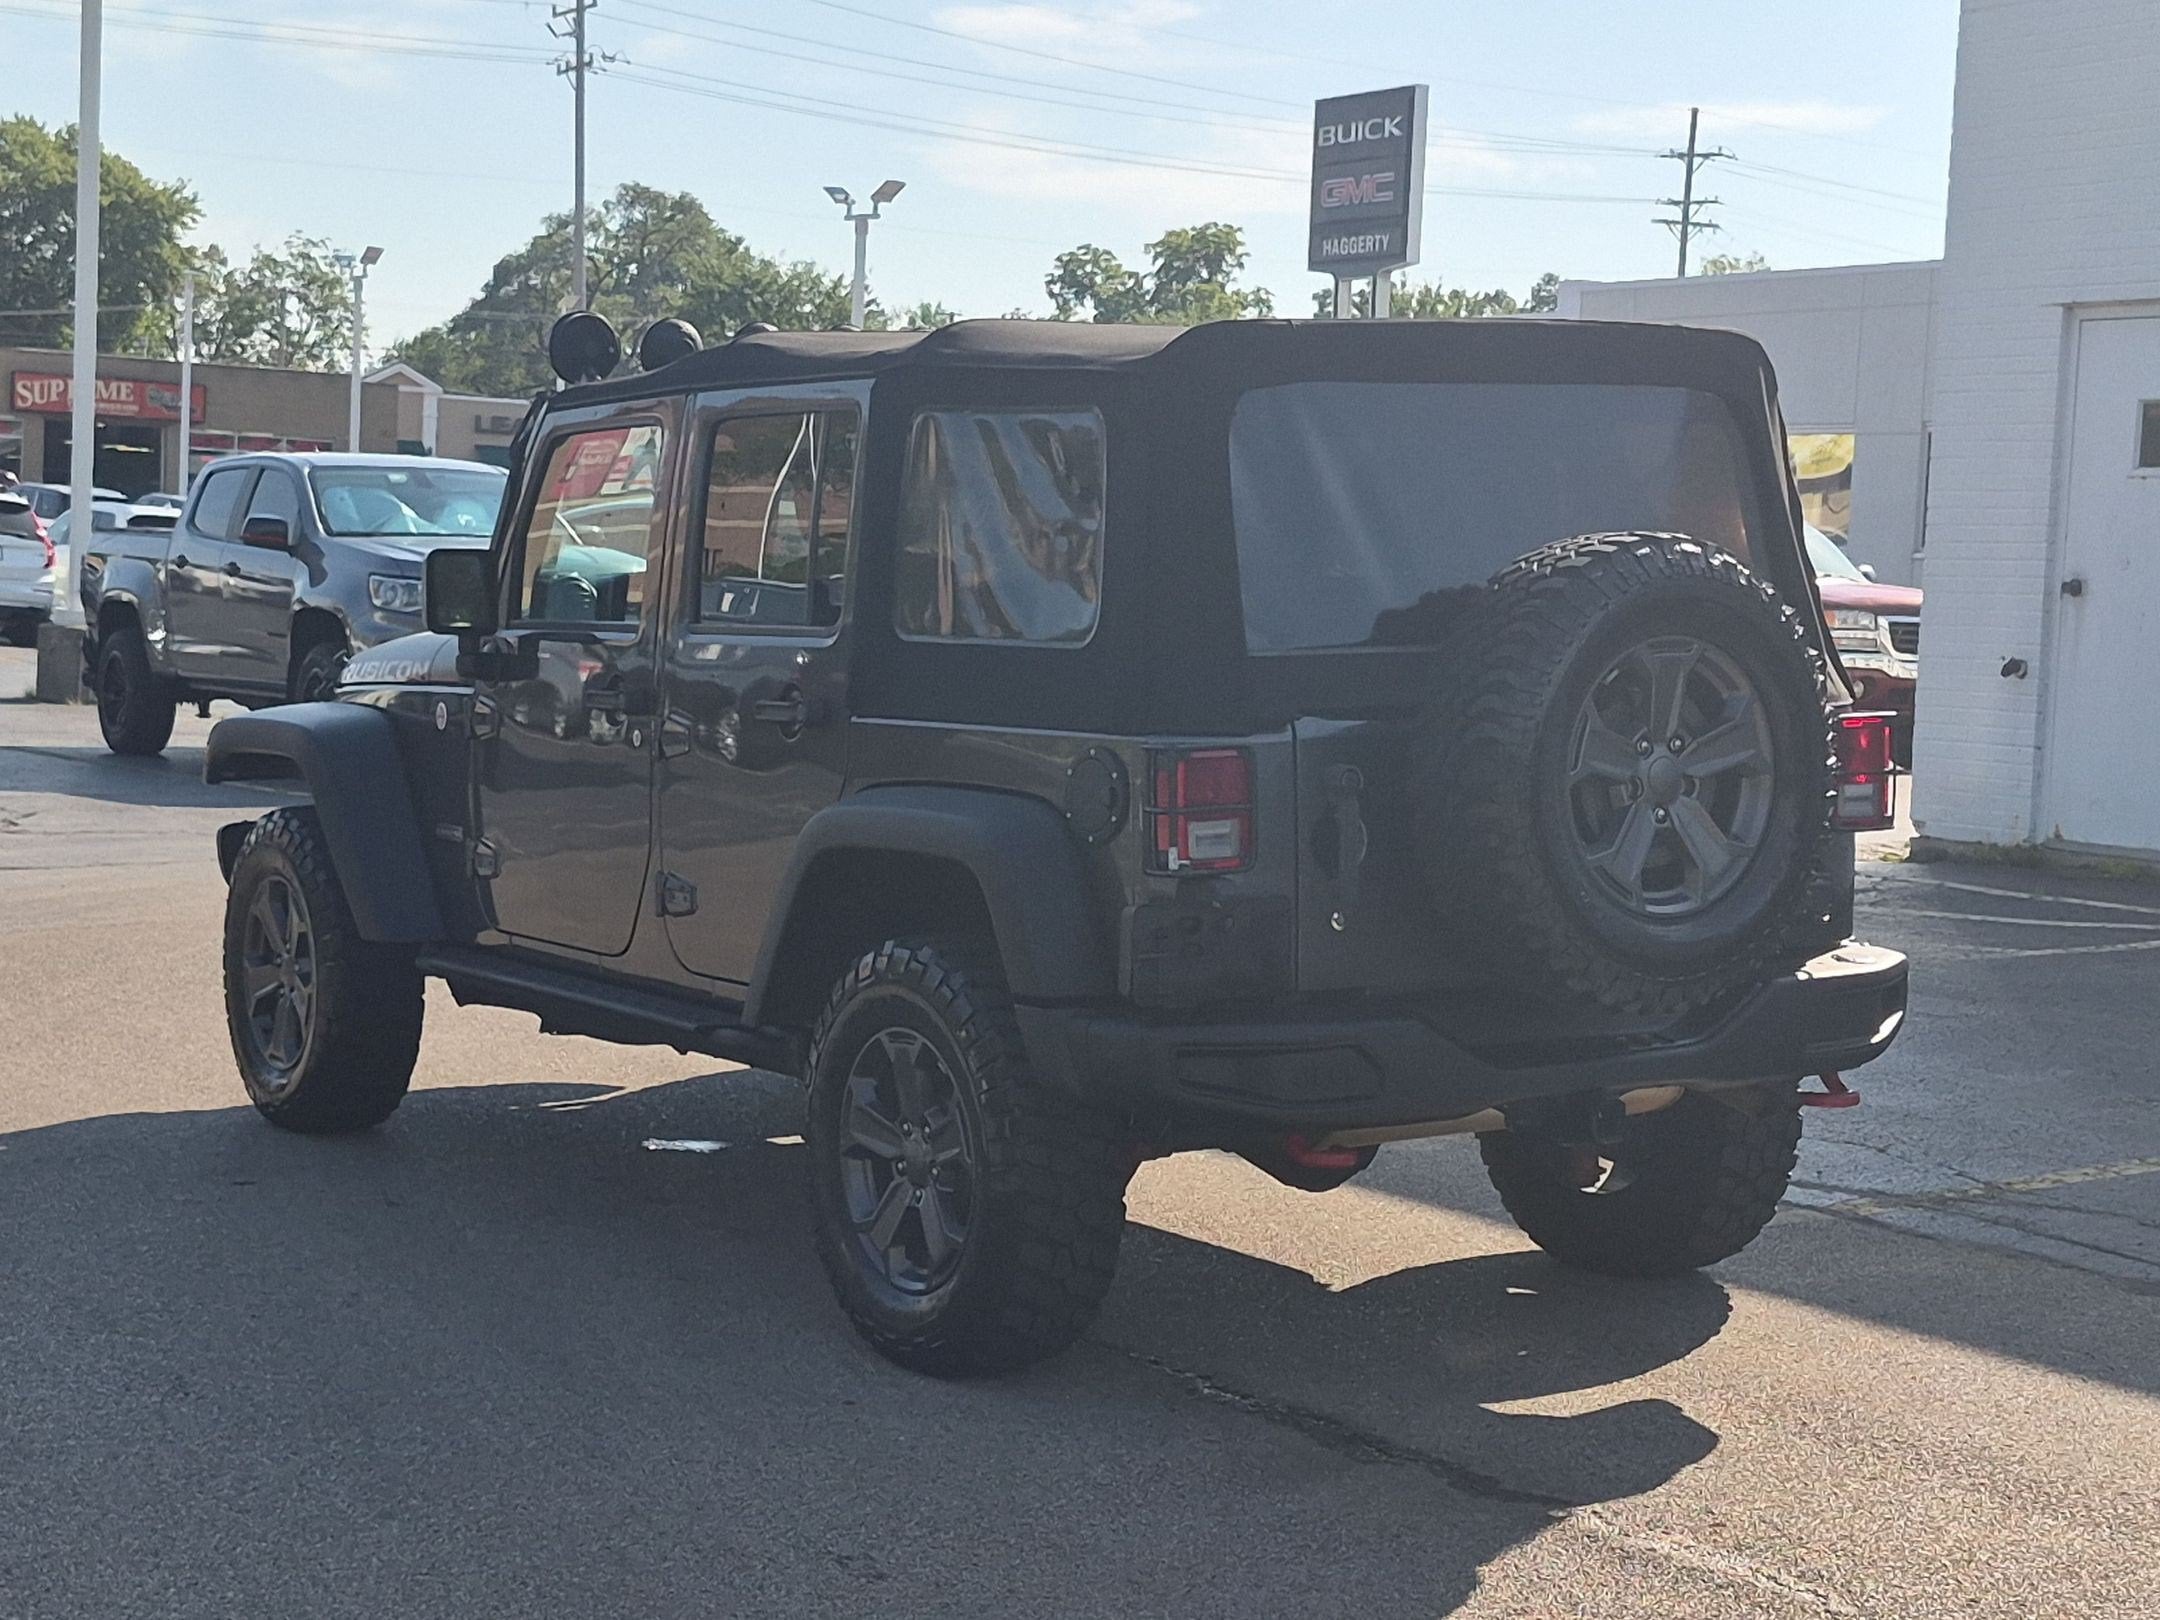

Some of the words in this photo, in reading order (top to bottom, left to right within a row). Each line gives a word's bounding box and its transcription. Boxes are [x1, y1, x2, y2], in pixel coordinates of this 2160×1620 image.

[1318, 116, 1402, 146] BUICK
[1320, 172, 1395, 208] GMC
[1323, 234, 1390, 256] HAGGERTY
[15, 378, 134, 408] SUPME
[342, 661, 430, 681] RUBICON
